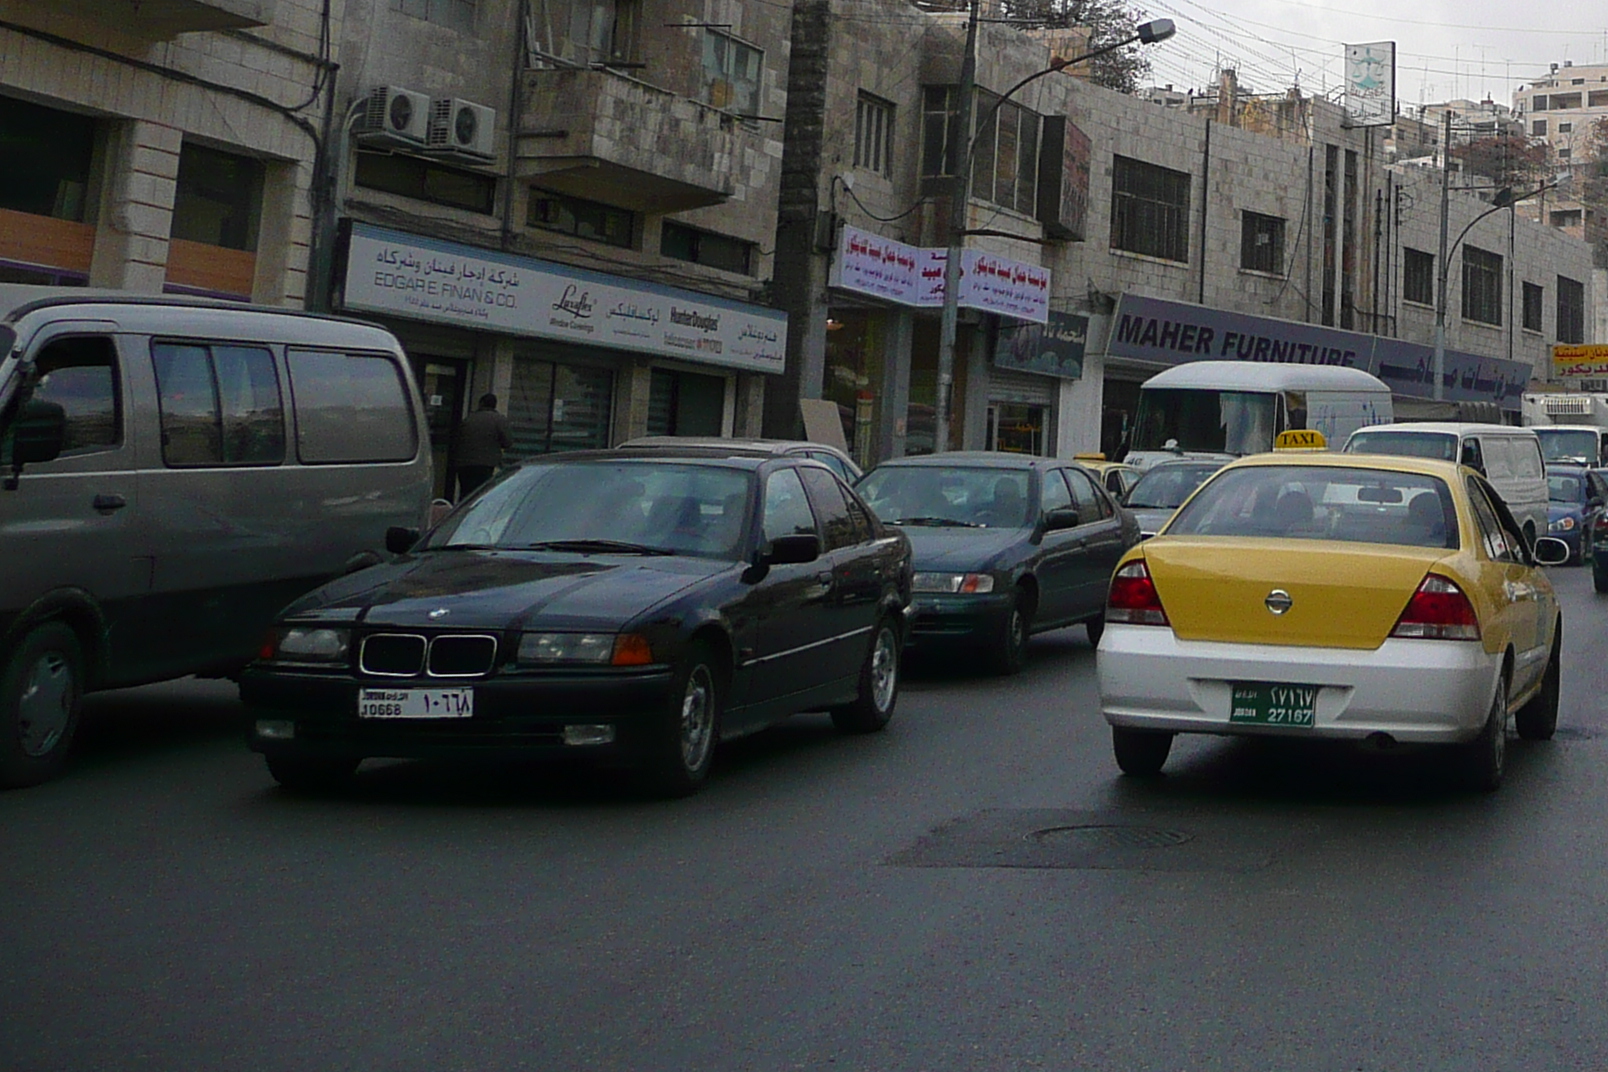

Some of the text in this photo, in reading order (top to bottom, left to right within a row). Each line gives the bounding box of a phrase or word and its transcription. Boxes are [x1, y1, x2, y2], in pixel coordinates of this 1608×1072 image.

[488, 268, 520, 290] شركة
[374, 270, 426, 293] EDGAR
[441, 283, 483, 303] FINAN
[484, 290, 495, 305] &
[496, 292, 518, 310] CO.
[1116, 314, 1356, 367] MAHER FURNITURE
[1281, 433, 1316, 445] TAXI
[361, 704, 402, 716] 10668
[424, 693, 471, 714] ١٠٦٦٨
[1267, 708, 1312, 723] 27167
